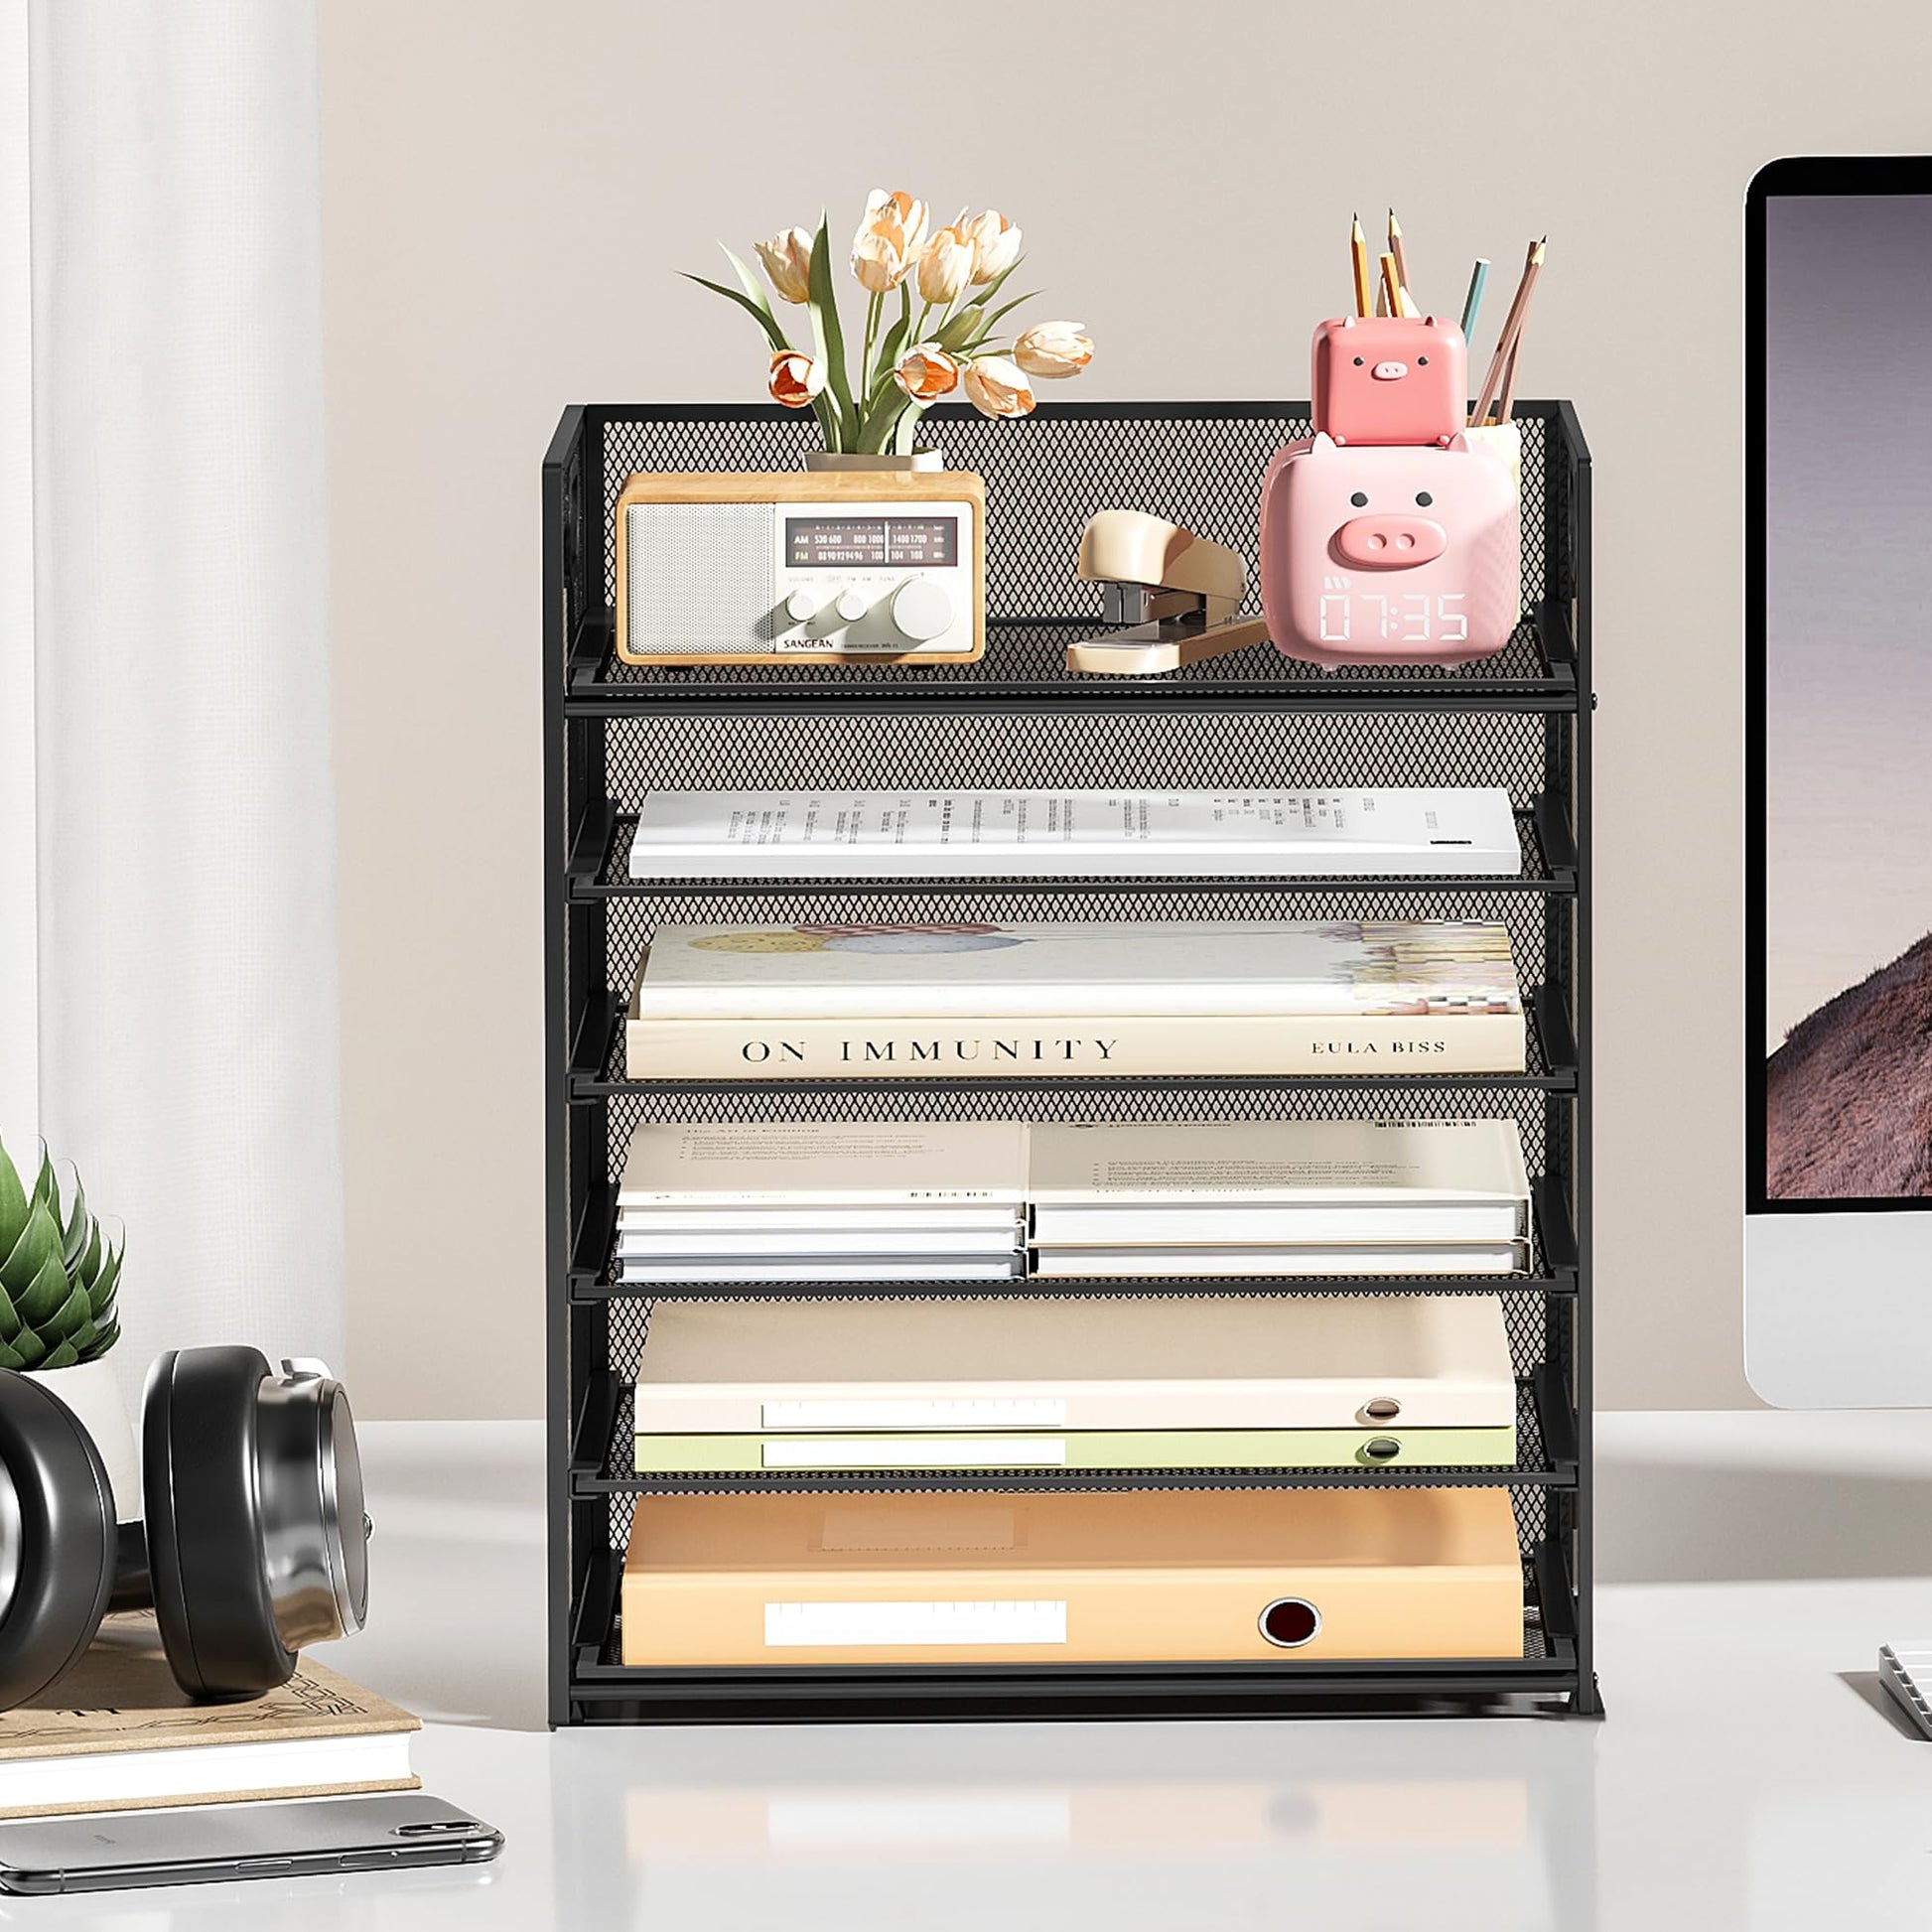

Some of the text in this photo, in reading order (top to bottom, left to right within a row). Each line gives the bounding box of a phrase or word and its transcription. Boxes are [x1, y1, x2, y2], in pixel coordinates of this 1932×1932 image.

[794, 535, 809, 544] AM
[794, 551, 809, 561] FM
[1319, 593, 1468, 642] 07:35
[783, 638, 834, 649] SANGEAN
[742, 1039, 1119, 1063] ON IMMUNITY
[1311, 1040, 1447, 1055] EULA BISS
